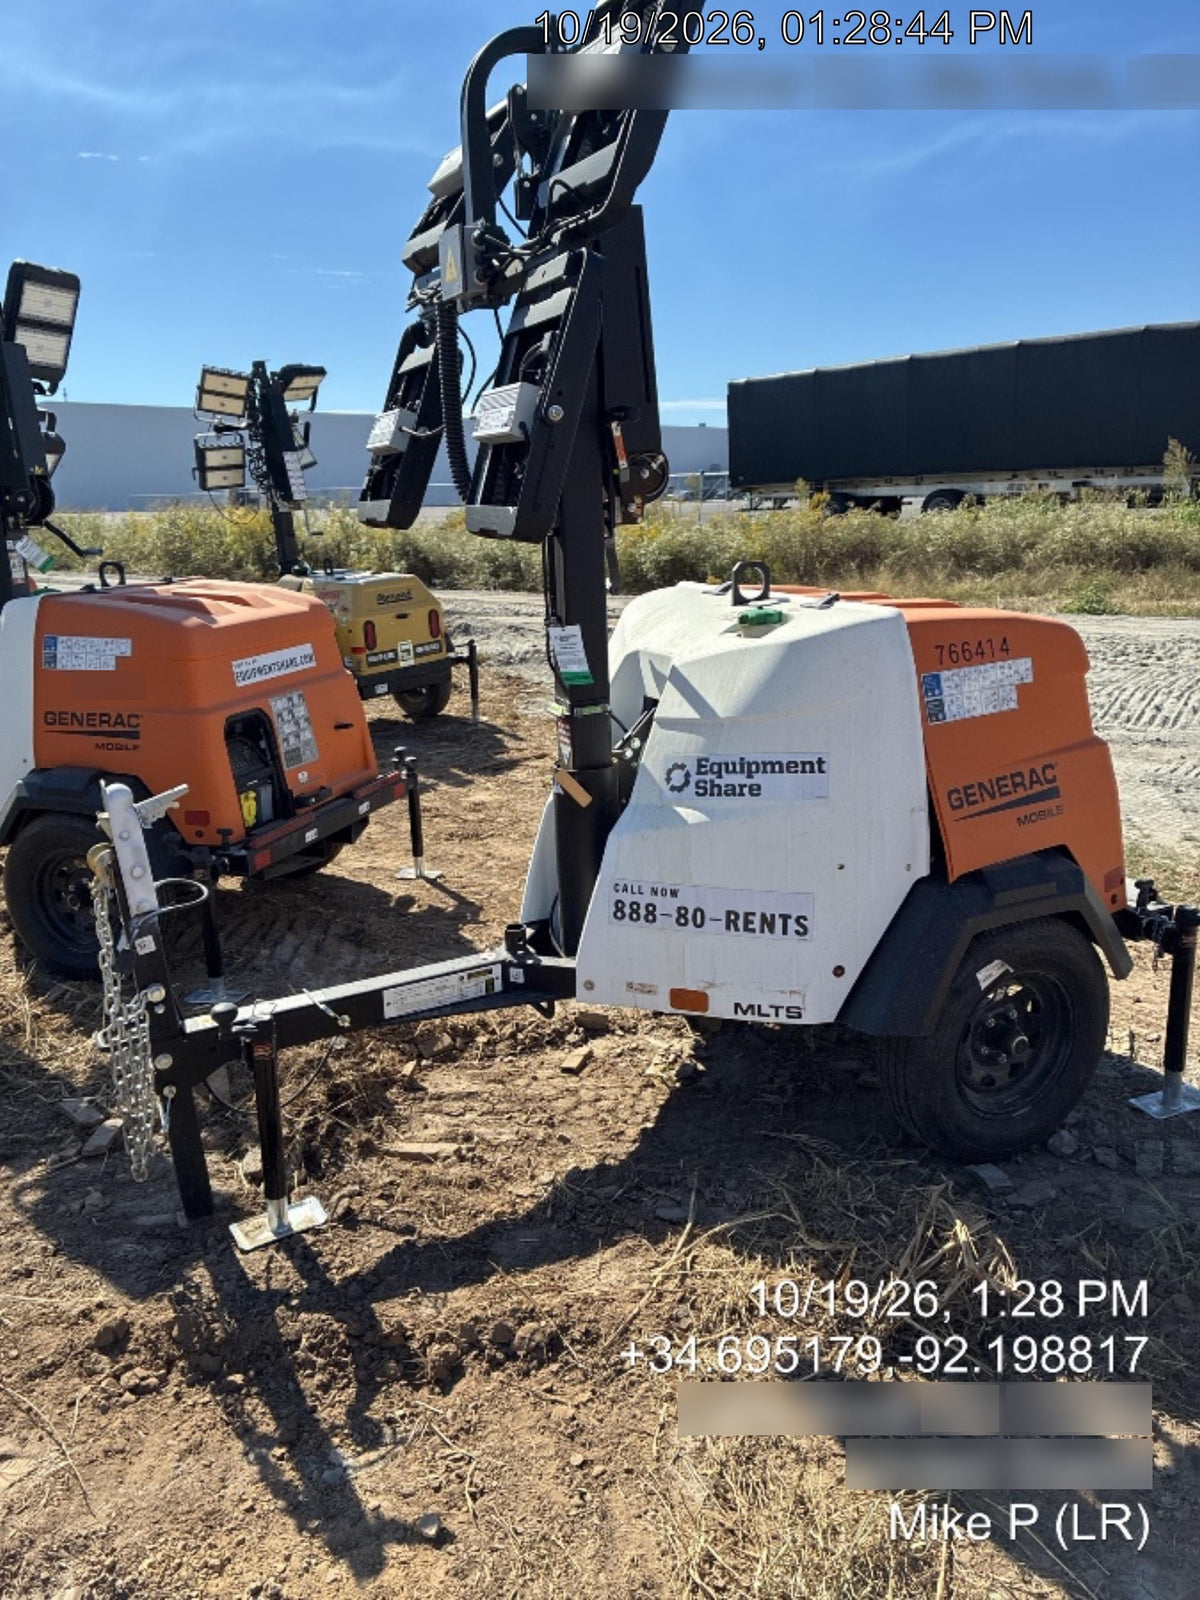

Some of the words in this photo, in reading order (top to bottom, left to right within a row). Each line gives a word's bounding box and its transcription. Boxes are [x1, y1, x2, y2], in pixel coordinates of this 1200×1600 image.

[934, 636, 1011, 665] 766414
[44, 710, 140, 729] GENERAC
[95, 742, 140, 752] MOBILE
[695, 757, 826, 779] Equipment
[694, 778, 762, 798] Share
[947, 763, 1058, 811] GENERAC
[1016, 805, 1064, 827] MOBILE
[613, 882, 645, 896] CALL
[650, 886, 681, 899] NOW
[612, 899, 810, 938] 888-80-RENTS
[733, 1002, 803, 1020] MLTS
